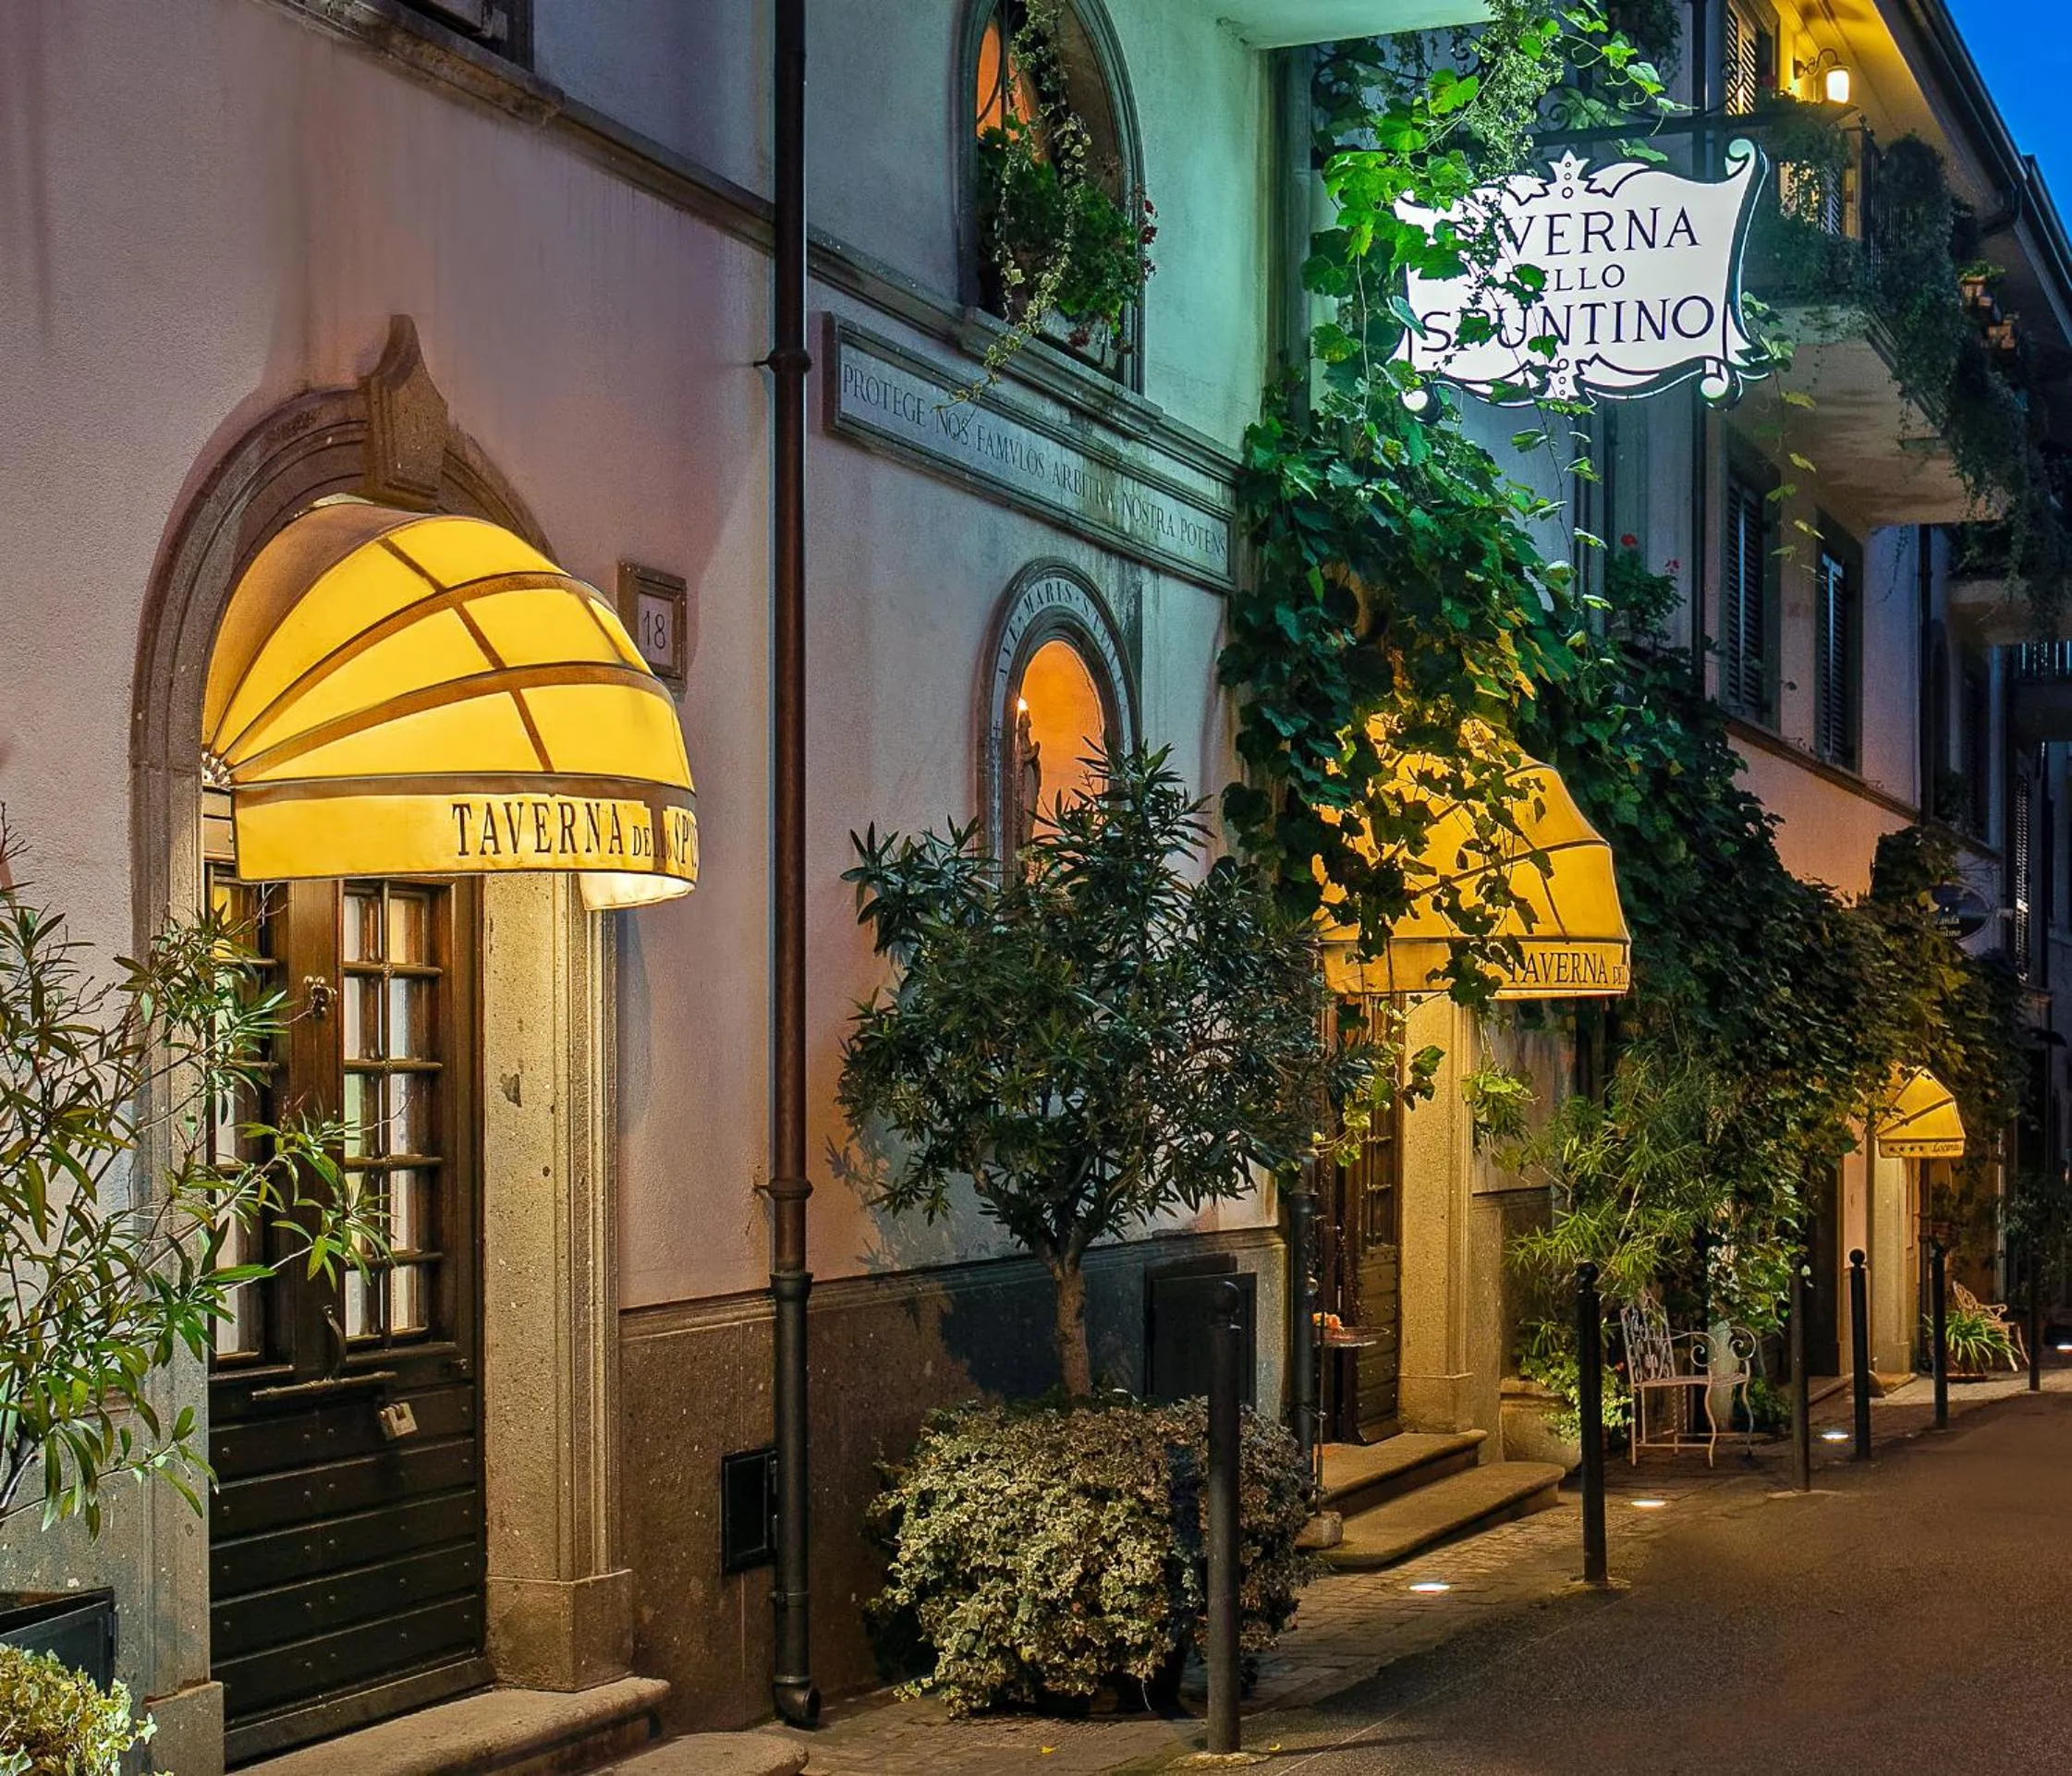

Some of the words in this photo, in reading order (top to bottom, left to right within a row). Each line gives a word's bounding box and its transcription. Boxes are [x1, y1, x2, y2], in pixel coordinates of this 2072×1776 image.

[1453, 206, 1700, 258] VERNA
[1505, 264, 1626, 294] LLO
[843, 363, 927, 428] PROTEGE
[934, 407, 970, 445] NOS
[1122, 491, 1175, 538] NOSTRA
[1180, 517, 1226, 555] POTENS
[643, 610, 665, 650] 18
[452, 802, 624, 856] TAVERNA
